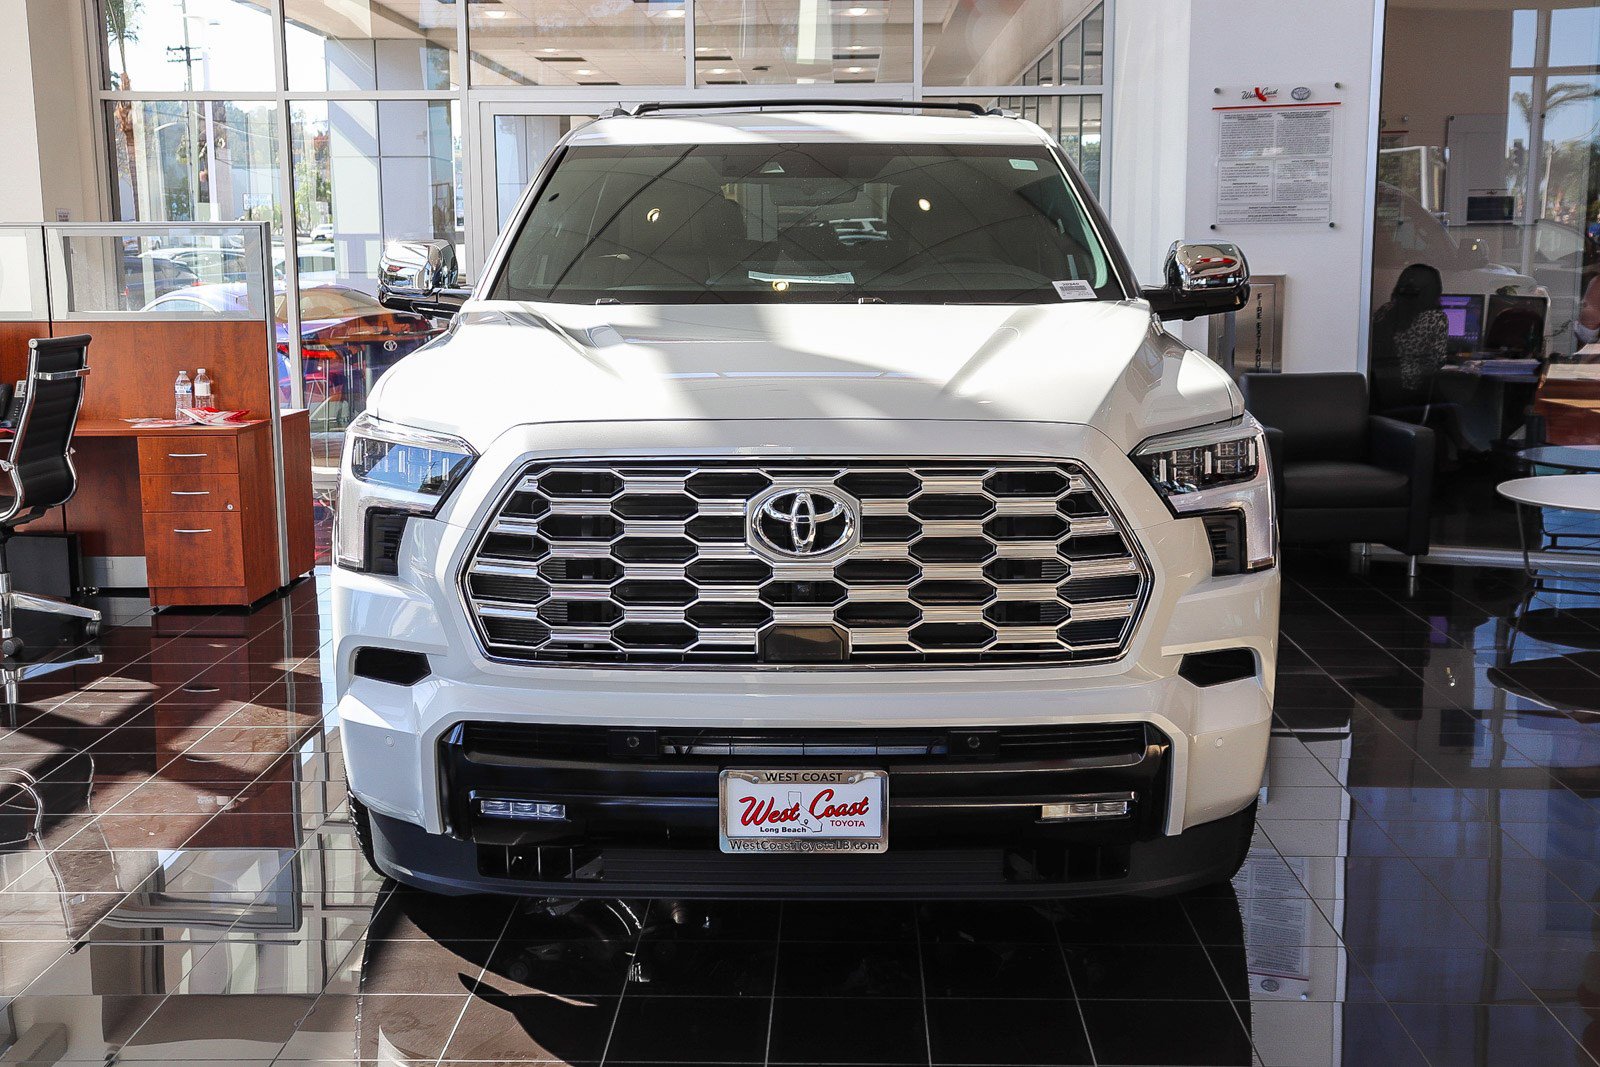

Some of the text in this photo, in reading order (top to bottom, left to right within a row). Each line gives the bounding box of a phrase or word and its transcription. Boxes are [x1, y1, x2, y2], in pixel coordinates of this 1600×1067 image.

[765, 773, 842, 781] WEST COAST
[739, 788, 869, 826] West Coast
[730, 840, 879, 852] WestCoastToyotaLB.com
